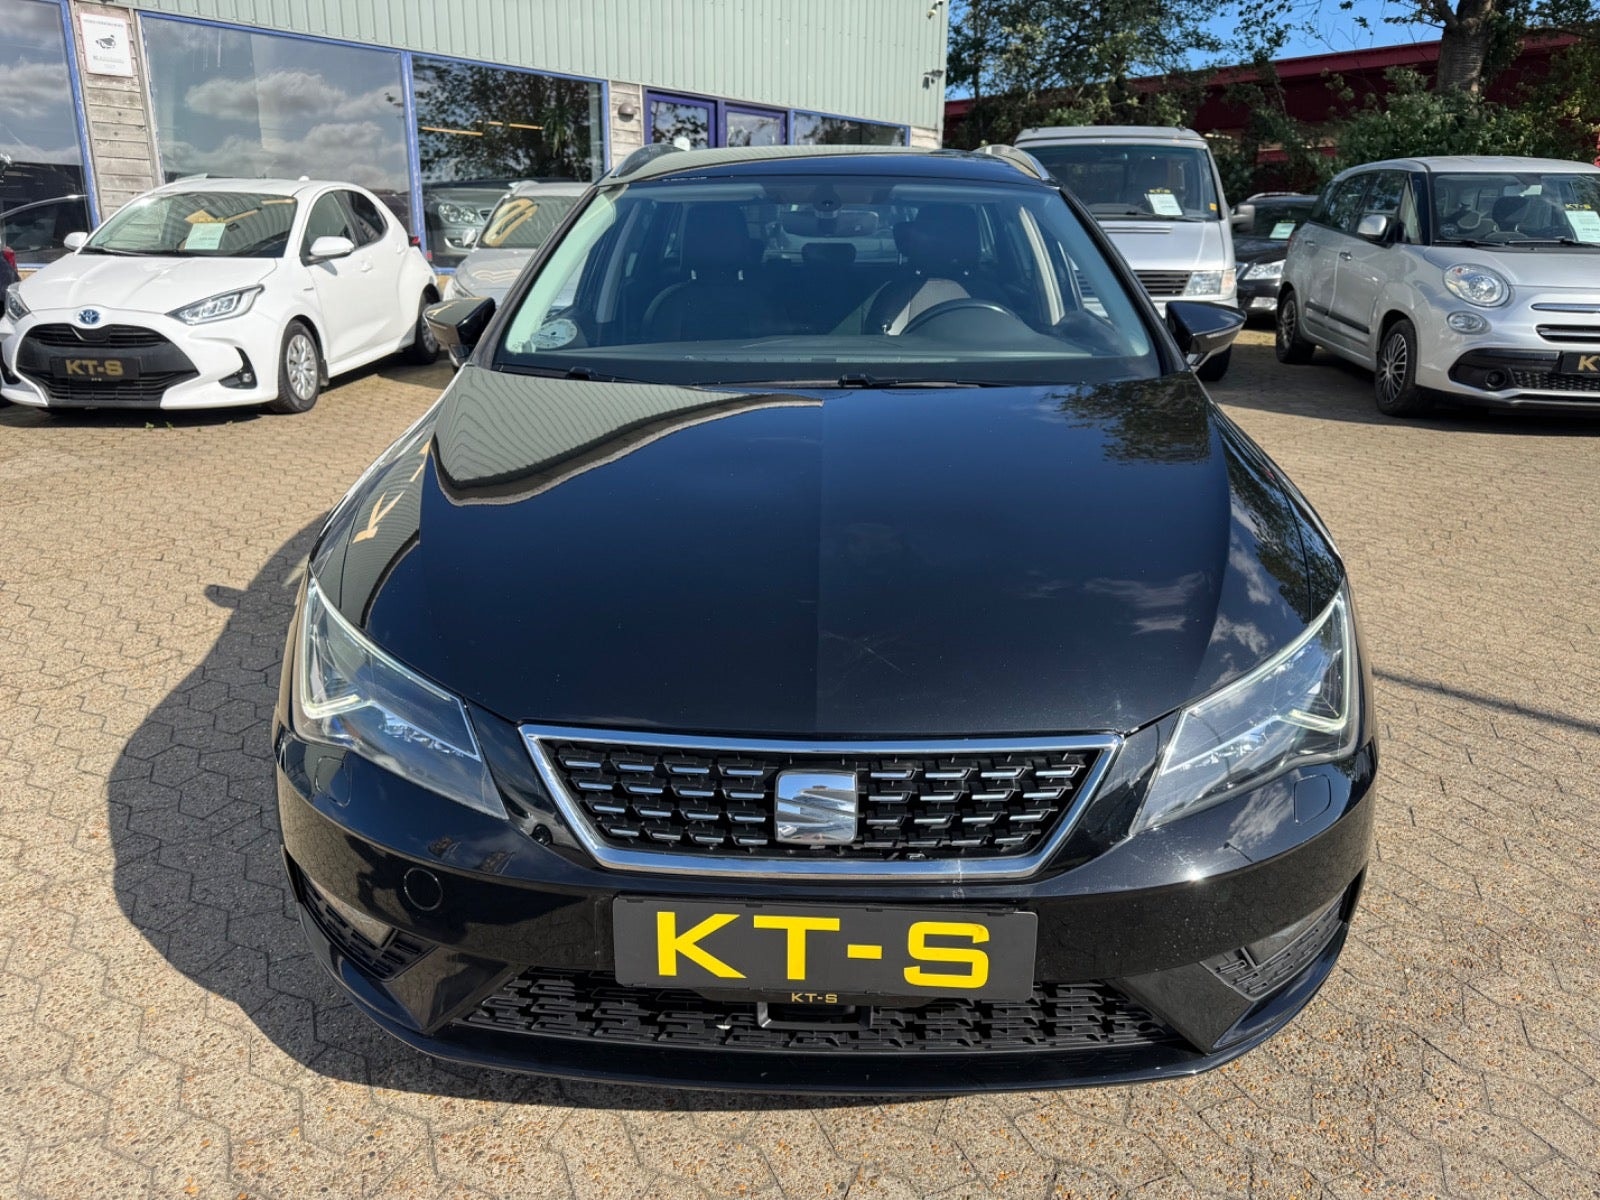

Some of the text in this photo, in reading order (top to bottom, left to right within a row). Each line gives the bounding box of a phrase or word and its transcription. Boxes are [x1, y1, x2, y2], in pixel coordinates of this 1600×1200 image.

[65, 359, 124, 376] KT-S
[1578, 355, 1600, 371] K
[657, 911, 990, 989] KT-S
[791, 992, 838, 1004] KT-S
